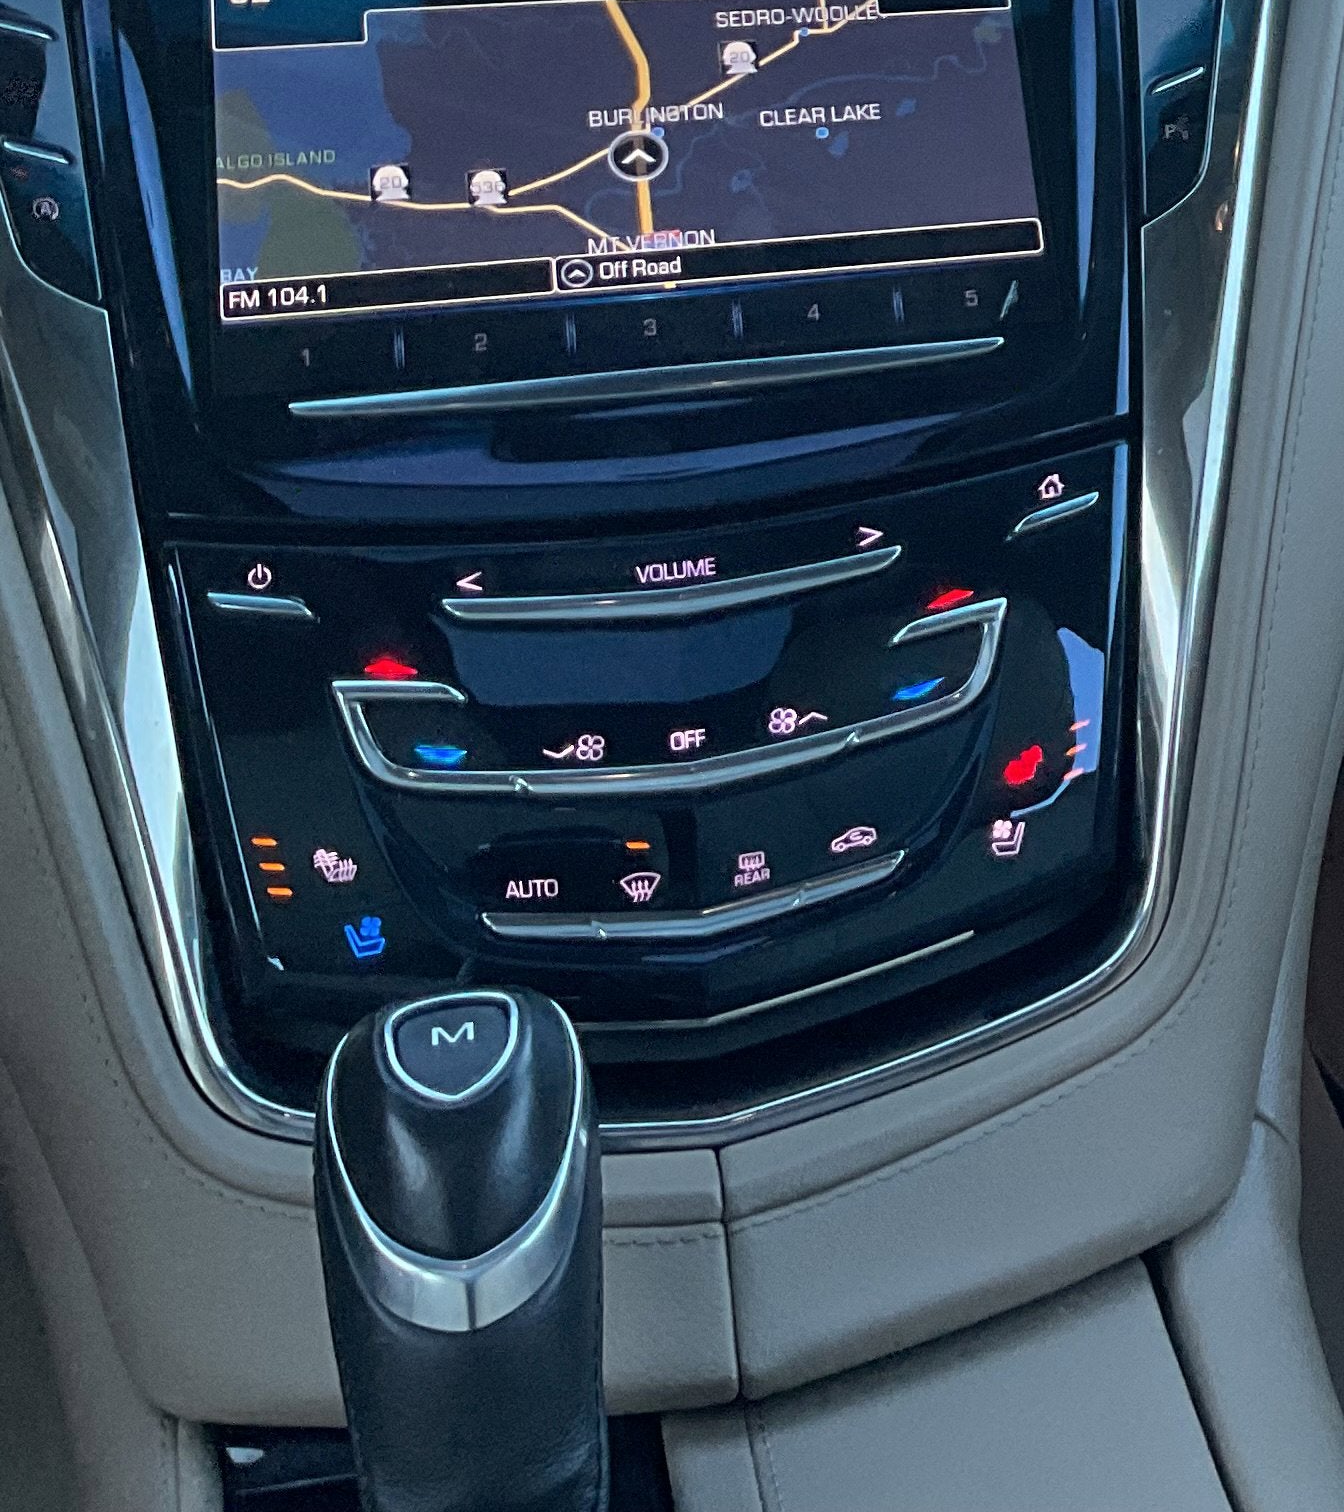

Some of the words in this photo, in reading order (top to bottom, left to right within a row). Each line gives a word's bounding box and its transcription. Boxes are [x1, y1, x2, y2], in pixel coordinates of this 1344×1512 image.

[715, 3, 887, 28] SEDRO-WOOLLE
[588, 102, 724, 128] BURLINGTON
[759, 106, 826, 127] CLEAR
[830, 103, 881, 123] LAKE
[269, 149, 336, 167] ISLAND
[625, 229, 715, 253] VERNON
[599, 260, 628, 280] Off
[632, 255, 682, 278] Road
[228, 289, 260, 310] FM
[267, 284, 327, 307] 104.1
[964, 289, 979, 308] 5
[806, 303, 820, 321] 4
[643, 317, 658, 337] 3
[473, 332, 488, 352] 2
[635, 556, 717, 584] VOLUME
[669, 728, 706, 751] OFF
[505, 878, 559, 899] AUTO
[734, 867, 771, 887] REAR
